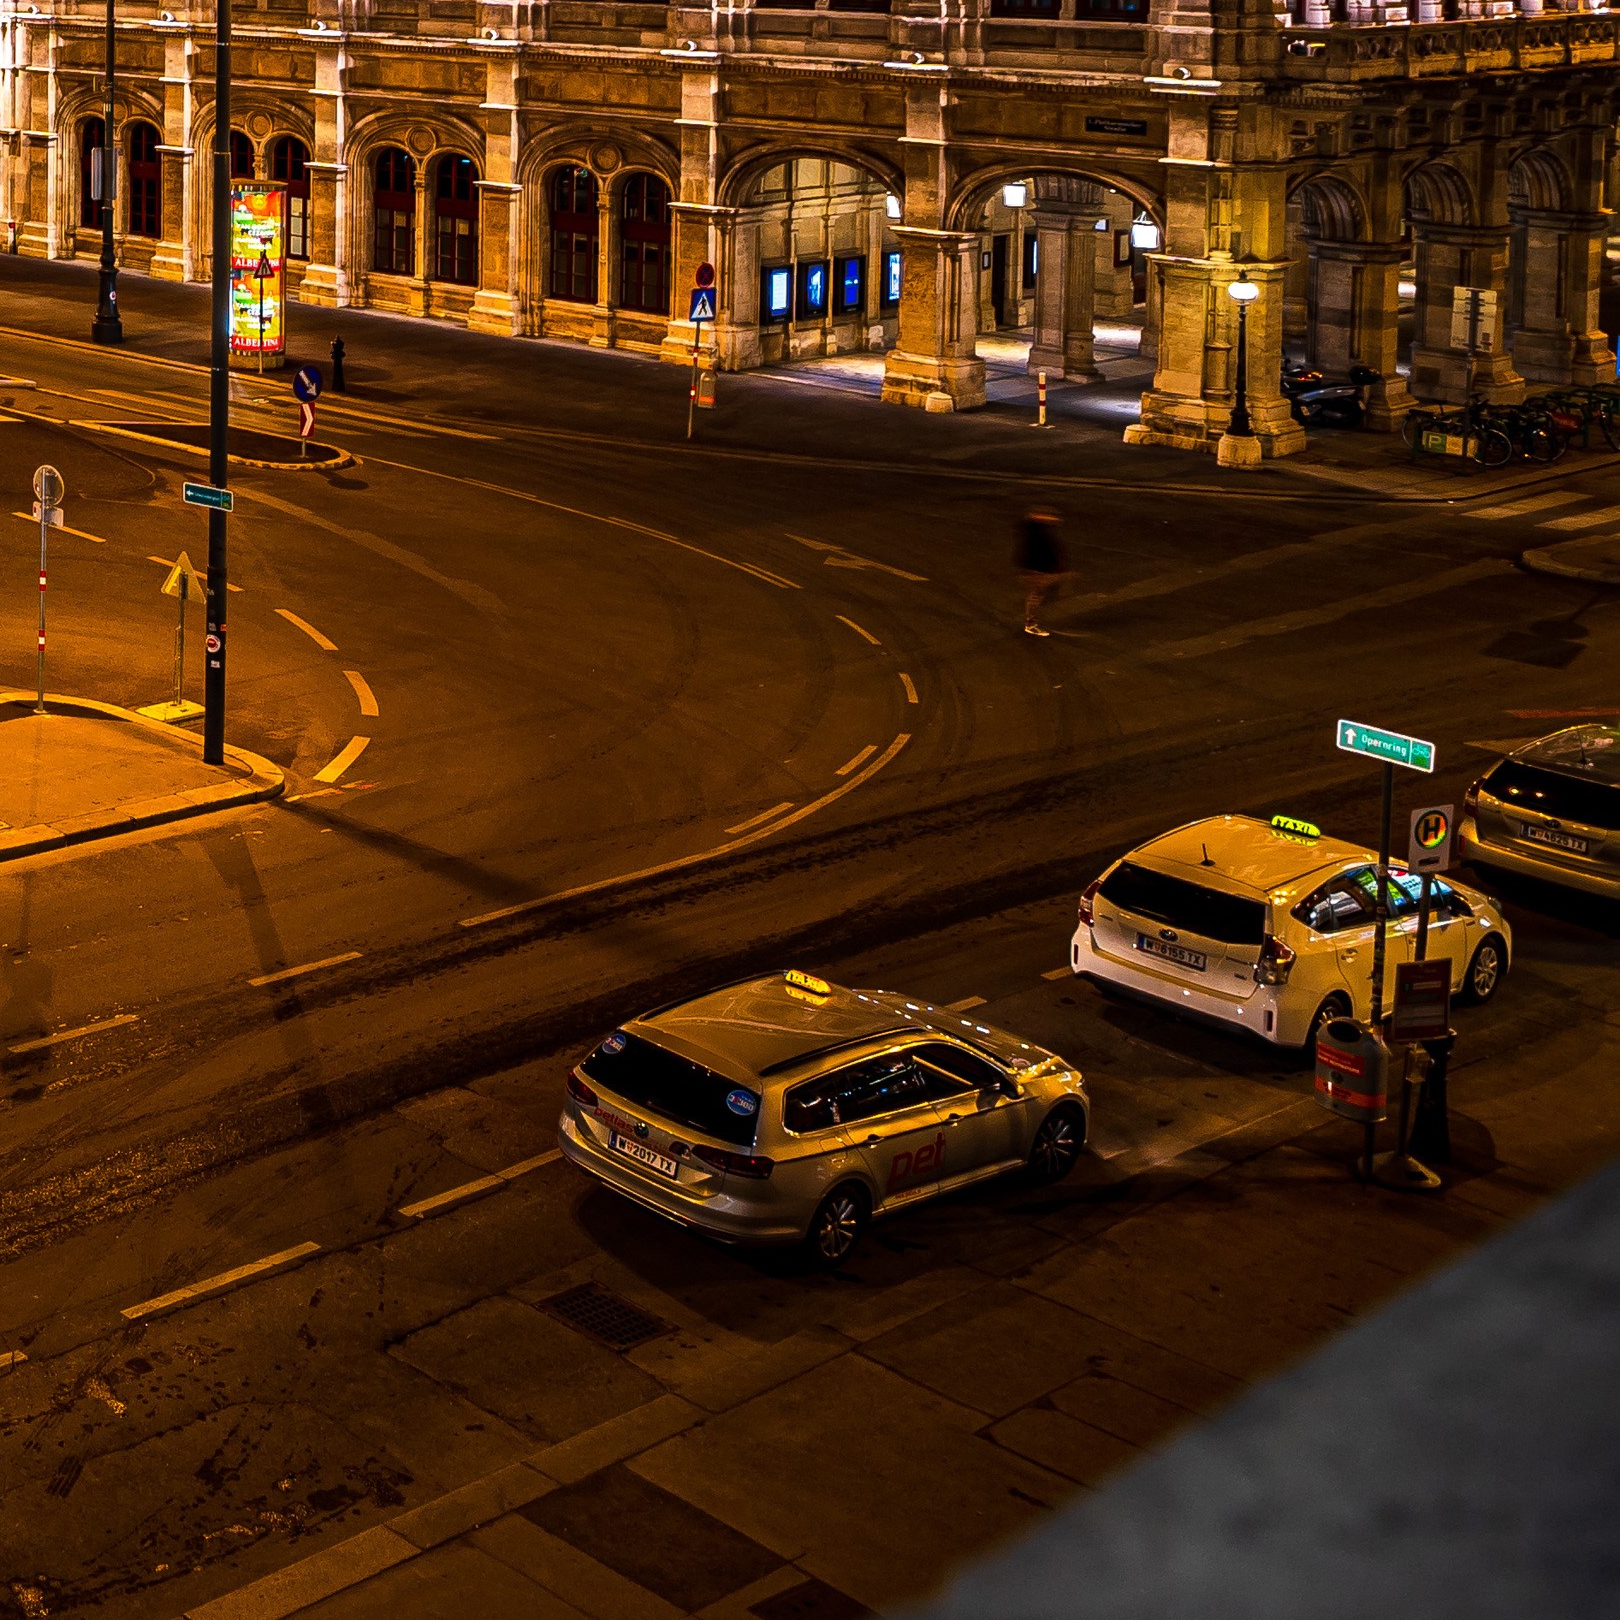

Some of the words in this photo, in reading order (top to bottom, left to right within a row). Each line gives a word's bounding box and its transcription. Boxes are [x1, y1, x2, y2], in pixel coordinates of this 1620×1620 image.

[1361, 734, 1408, 757] Opernring
[1422, 816, 1441, 841] H
[632, 1145, 658, 1164] 2017
[660, 1157, 672, 1172] TX
